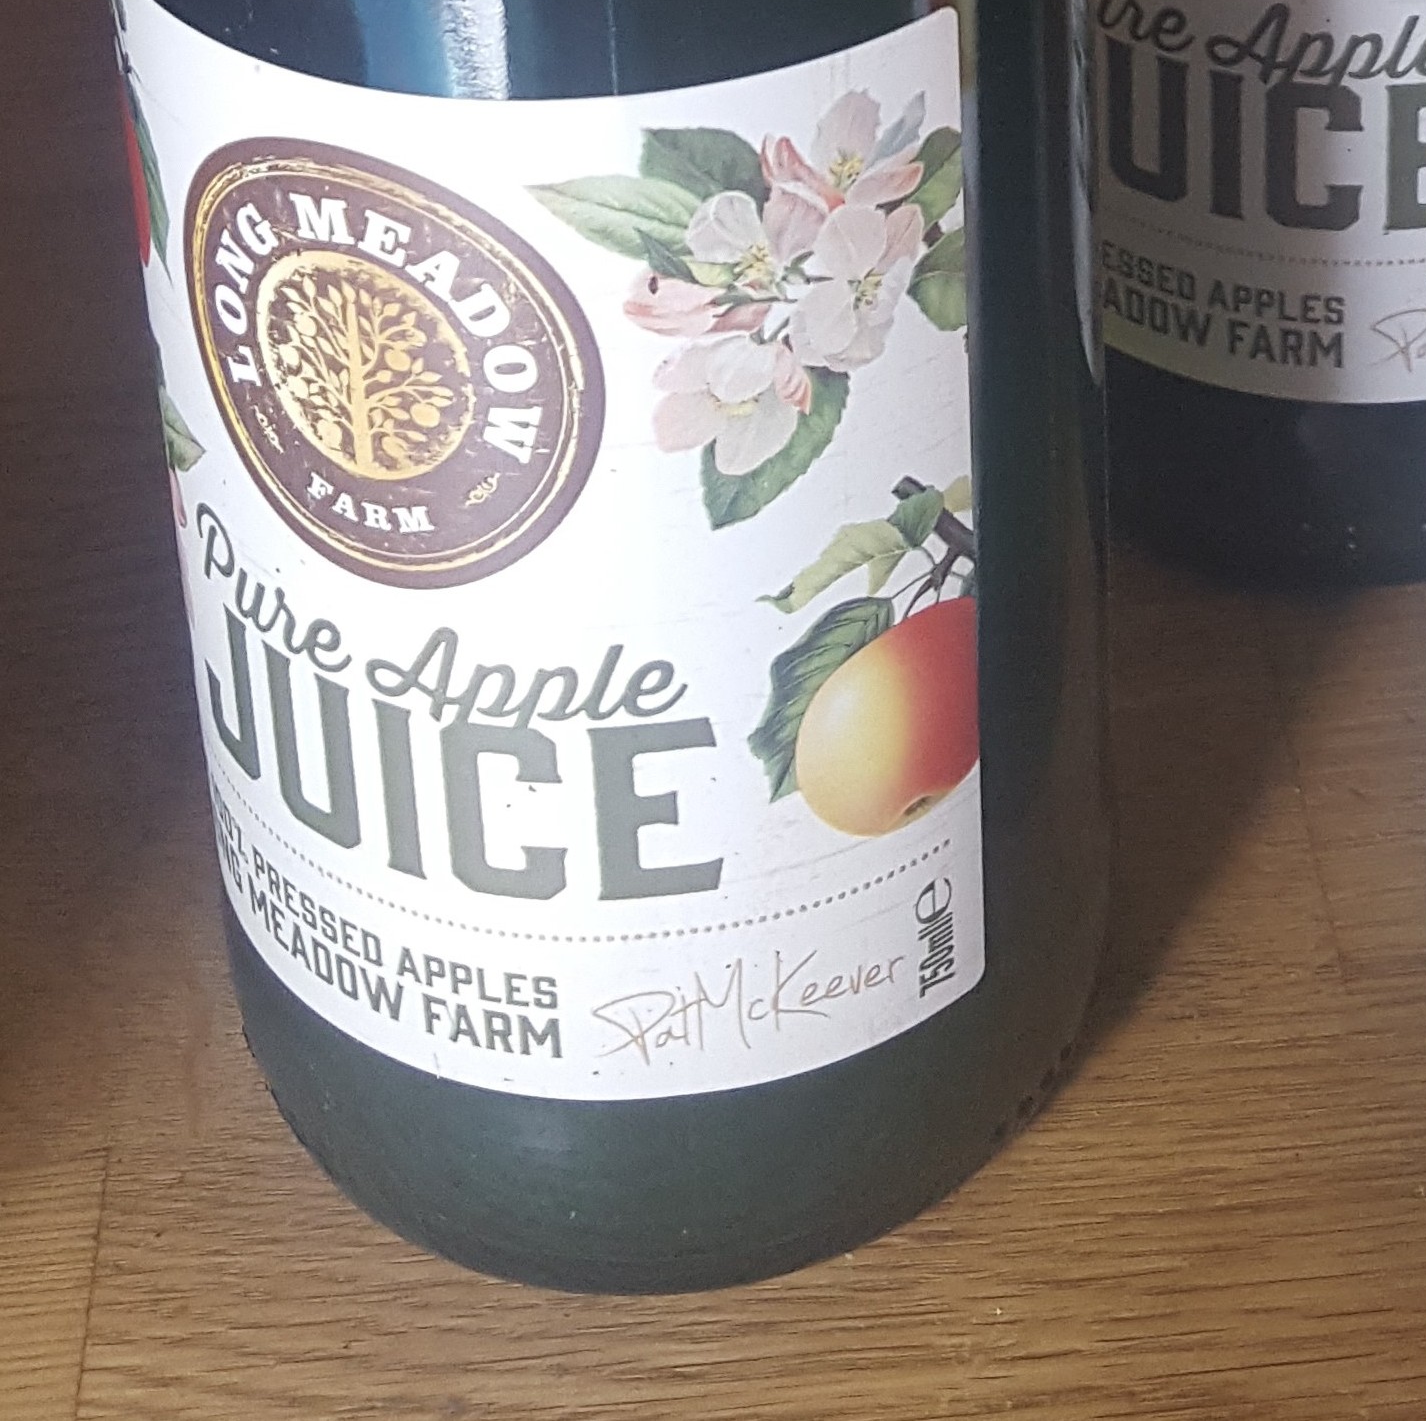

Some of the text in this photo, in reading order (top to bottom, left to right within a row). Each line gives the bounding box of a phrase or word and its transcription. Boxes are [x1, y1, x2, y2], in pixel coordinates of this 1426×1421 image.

[211, 191, 543, 465] LONG MEADOW
[1101, 239, 1346, 326] ESSED APPLES
[1102, 277, 1345, 369] ADOW FARM
[306, 470, 436, 537] FARM
[196, 501, 689, 731] Pure Apple
[206, 602, 724, 903] JUICE
[248, 872, 405, 1022] MEADOW
[423, 997, 564, 1060] FARM
[251, 844, 383, 968] PRESSED
[397, 947, 559, 1011] APPLES
